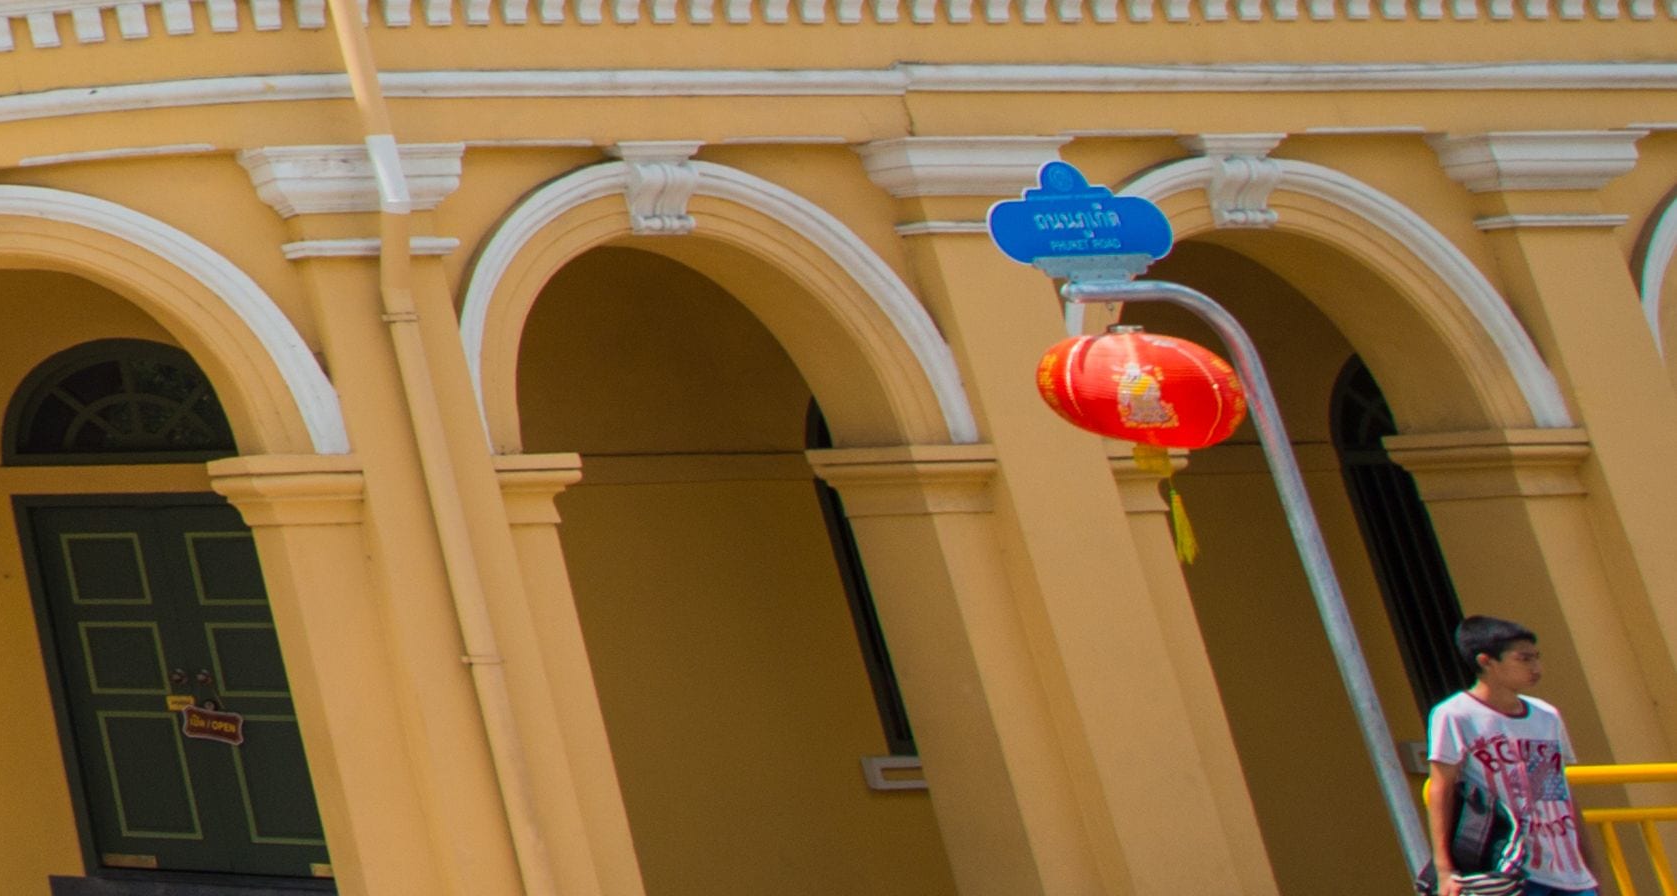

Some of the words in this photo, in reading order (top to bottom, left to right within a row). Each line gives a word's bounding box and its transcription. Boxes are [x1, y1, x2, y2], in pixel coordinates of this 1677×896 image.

[1050, 240, 1089, 251] PHUKET
[1092, 238, 1121, 249] ROAD
[211, 720, 237, 733] OPEN
